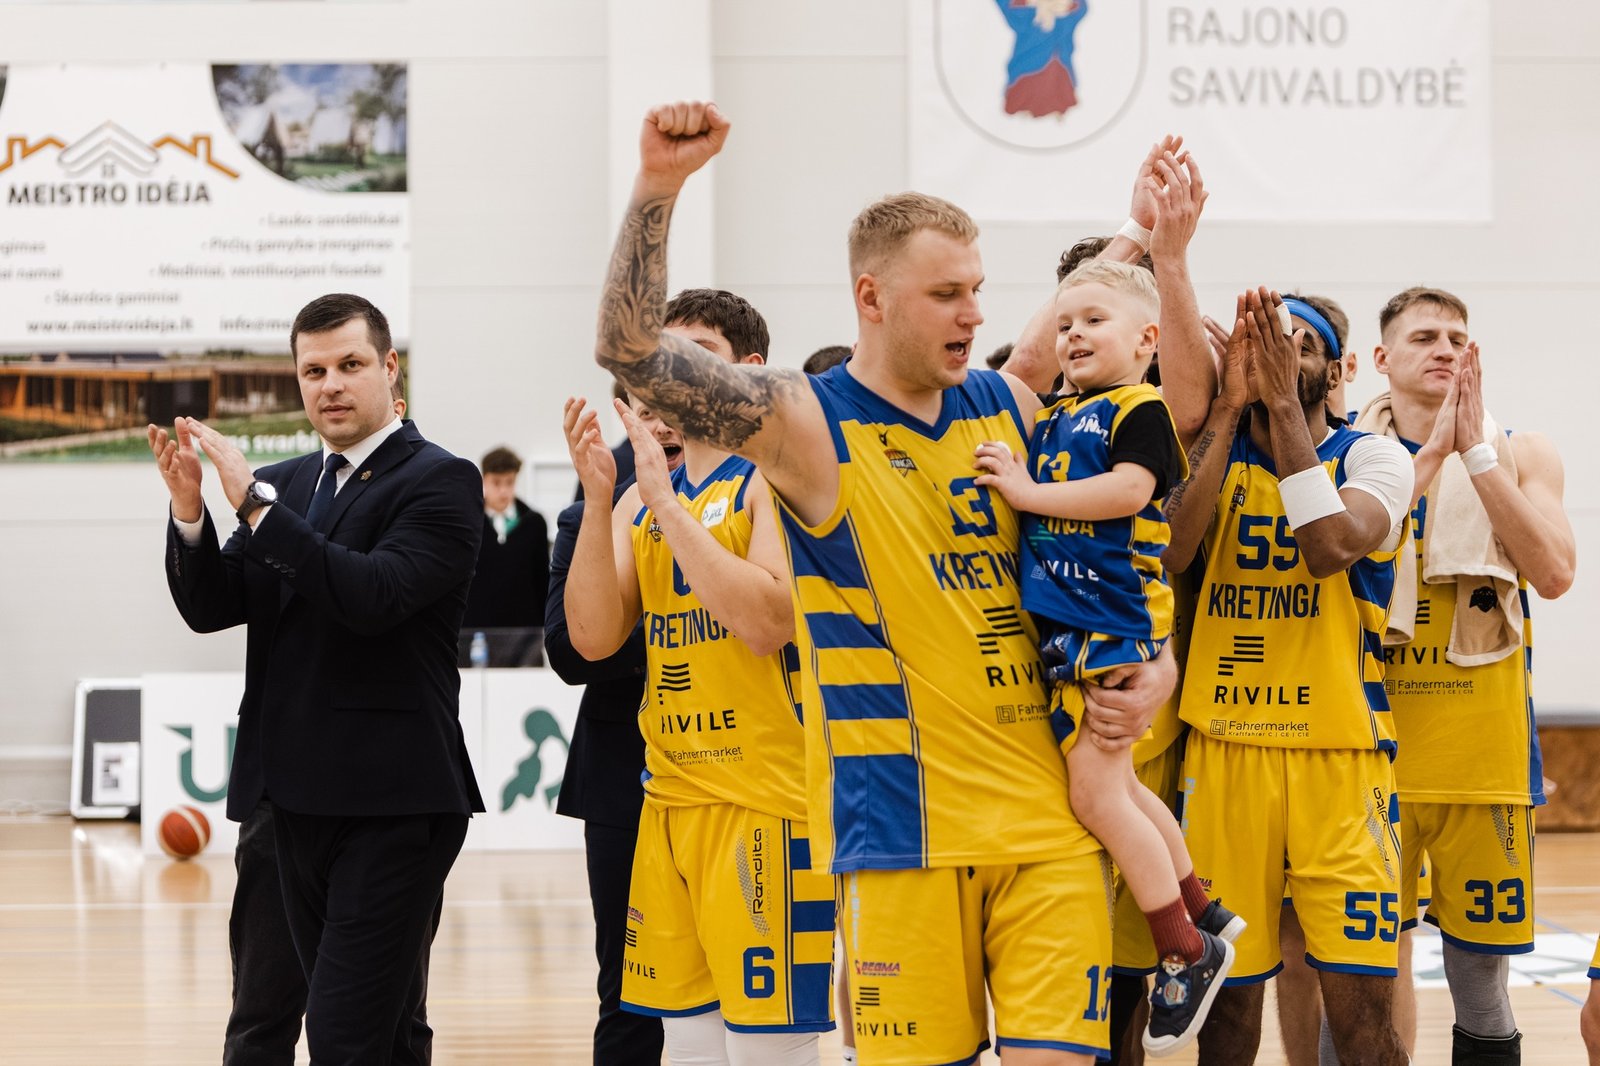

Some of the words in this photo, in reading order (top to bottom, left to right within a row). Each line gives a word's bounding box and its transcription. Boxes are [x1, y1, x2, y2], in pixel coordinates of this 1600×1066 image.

[1168, 6, 1348, 47] RAJONO
[1168, 59, 1466, 108] SAVIVALDYBĖ
[7, 182, 129, 206] MEISTRO
[135, 175, 213, 206] IDĖJA
[1214, 685, 1310, 705] RIVILE
[1398, 679, 1474, 689] Fahrermarket
[1229, 720, 1309, 732] Fahrermarket
[1343, 891, 1399, 942] 55
[1465, 878, 1525, 923] 33
[743, 946, 775, 999] 6
[857, 1022, 917, 1037] RIVILE
